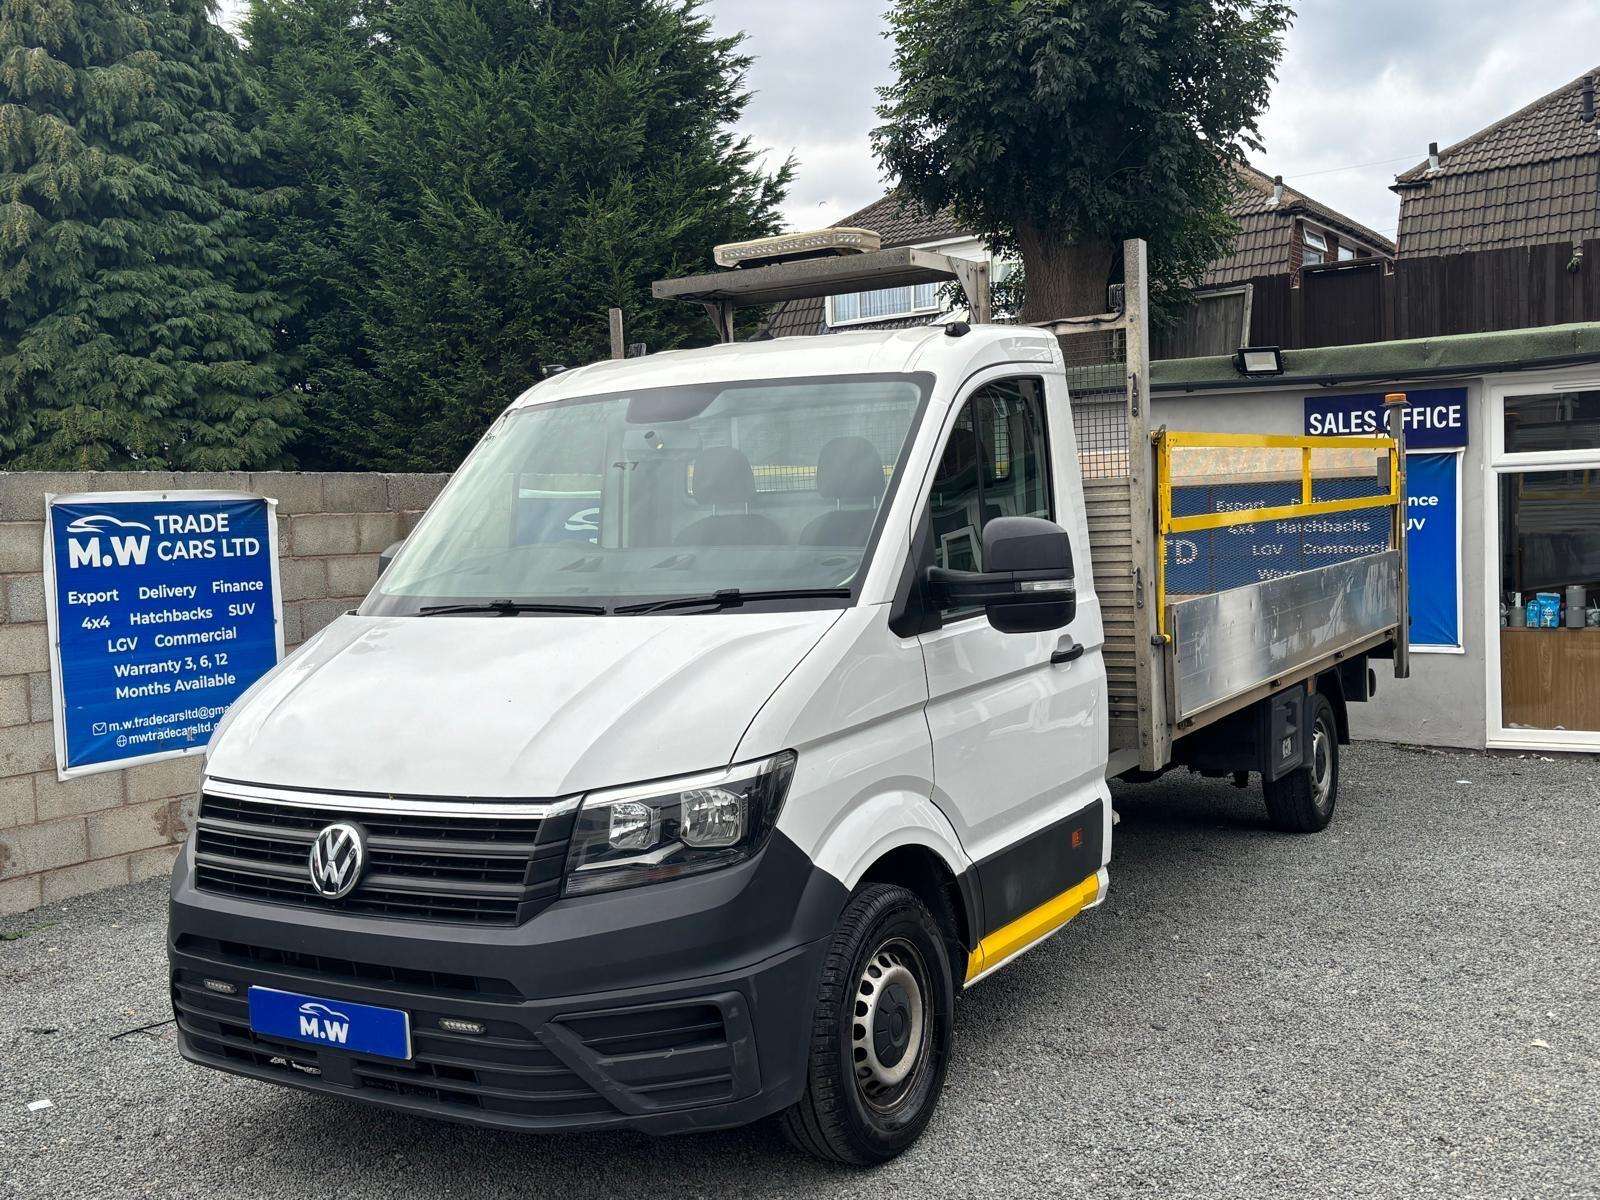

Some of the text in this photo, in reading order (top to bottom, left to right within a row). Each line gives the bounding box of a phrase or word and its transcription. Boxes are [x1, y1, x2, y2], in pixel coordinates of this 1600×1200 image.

[1309, 410, 1377, 435] SALES
[154, 513, 230, 534] TRADE
[68, 535, 151, 569] M.W
[157, 538, 260, 561] CARS LTD
[1304, 541, 1388, 555] Commerci
[68, 580, 264, 606] Export Delivery Finance
[81, 603, 255, 629] 4x4 Hatchbacks SUV
[108, 627, 237, 653] LGV Commercial
[114, 653, 228, 678] Warranty 3, 6, 12
[116, 673, 236, 700] Months Available
[109, 703, 232, 731] m.w.tradecarsltd@gma
[300, 1015, 349, 1044] M.W
